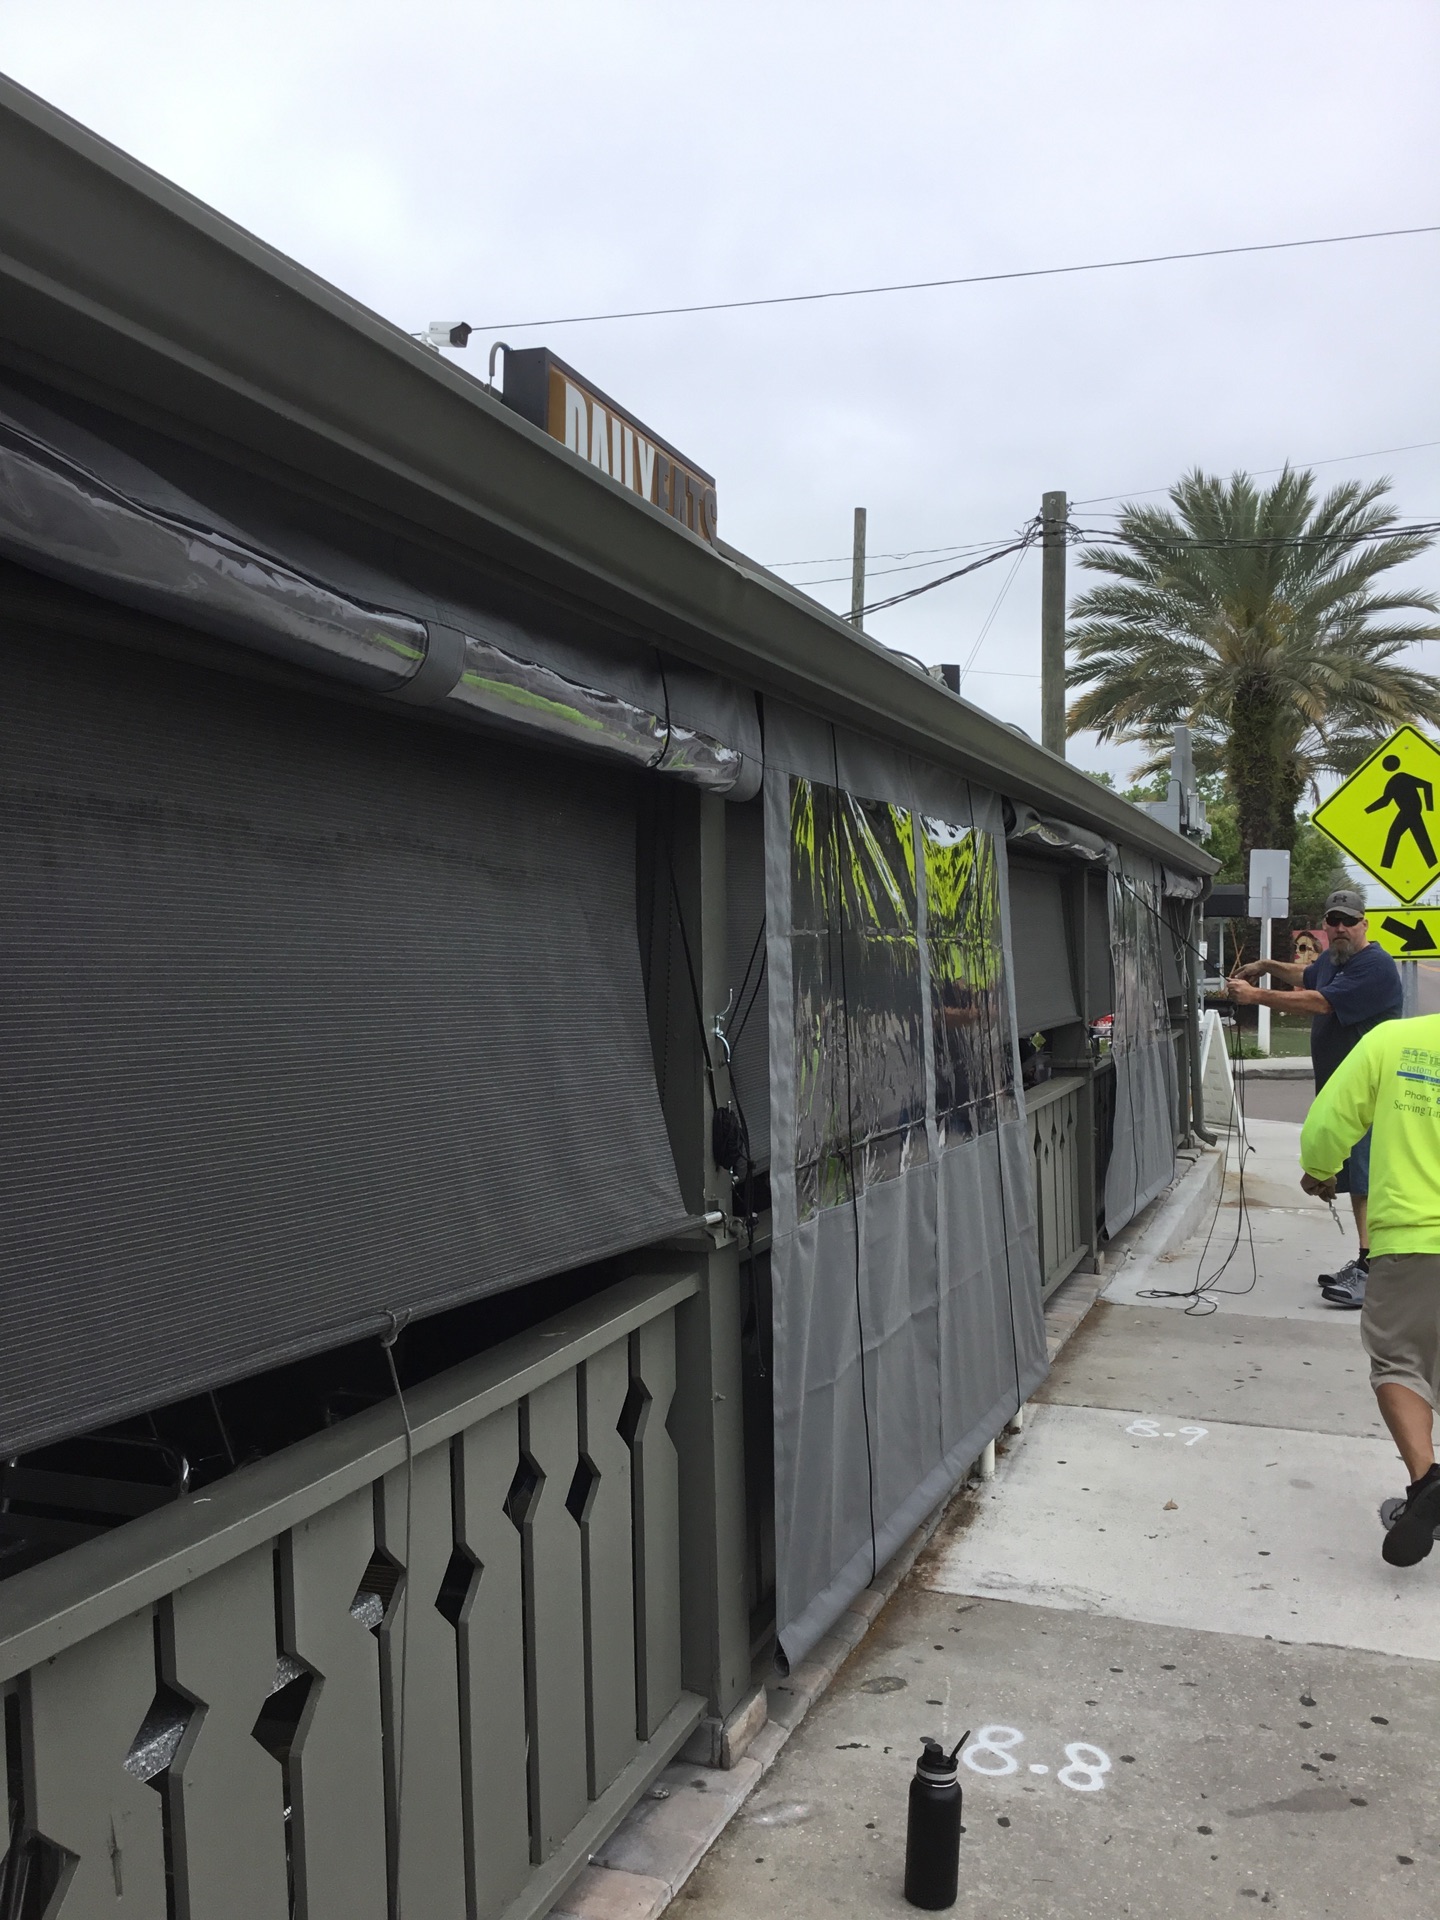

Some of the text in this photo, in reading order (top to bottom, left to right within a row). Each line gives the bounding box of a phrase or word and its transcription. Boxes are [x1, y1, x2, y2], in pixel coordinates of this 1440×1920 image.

[1400, 1062, 1431, 1076] Custom
[1405, 1090, 1431, 1102] Phone
[1394, 1100, 1426, 1116] Serving
